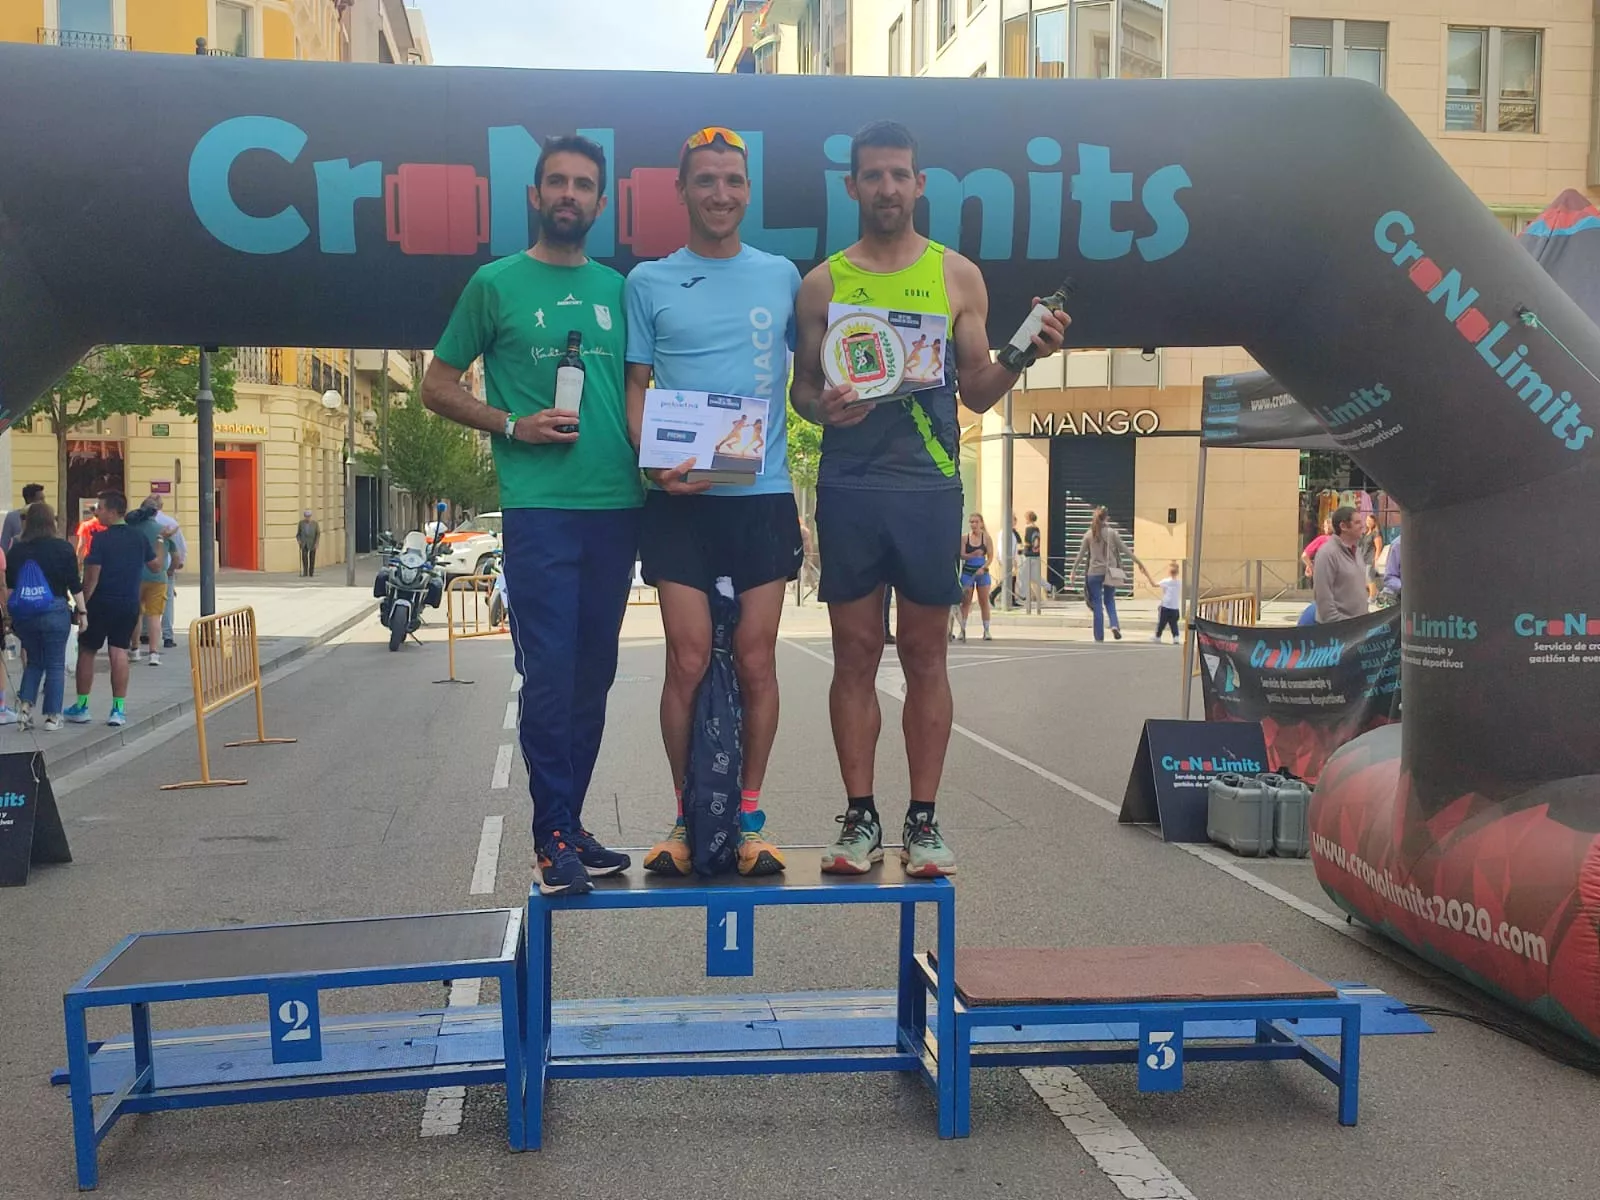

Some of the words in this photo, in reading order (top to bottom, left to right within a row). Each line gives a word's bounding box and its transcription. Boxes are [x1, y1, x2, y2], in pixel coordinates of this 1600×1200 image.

[1029, 409, 1160, 436] MANGO
[1529, 653, 1566, 664] gestión
[1568, 653, 1580, 663] de
[1534, 641, 1572, 651] Servicio
[1574, 641, 1587, 651] de
[1312, 831, 1549, 966] www.cronolimits2020.com
[718, 911, 740, 951] 1
[278, 1000, 312, 1042] 2
[1146, 1031, 1176, 1070] 3
